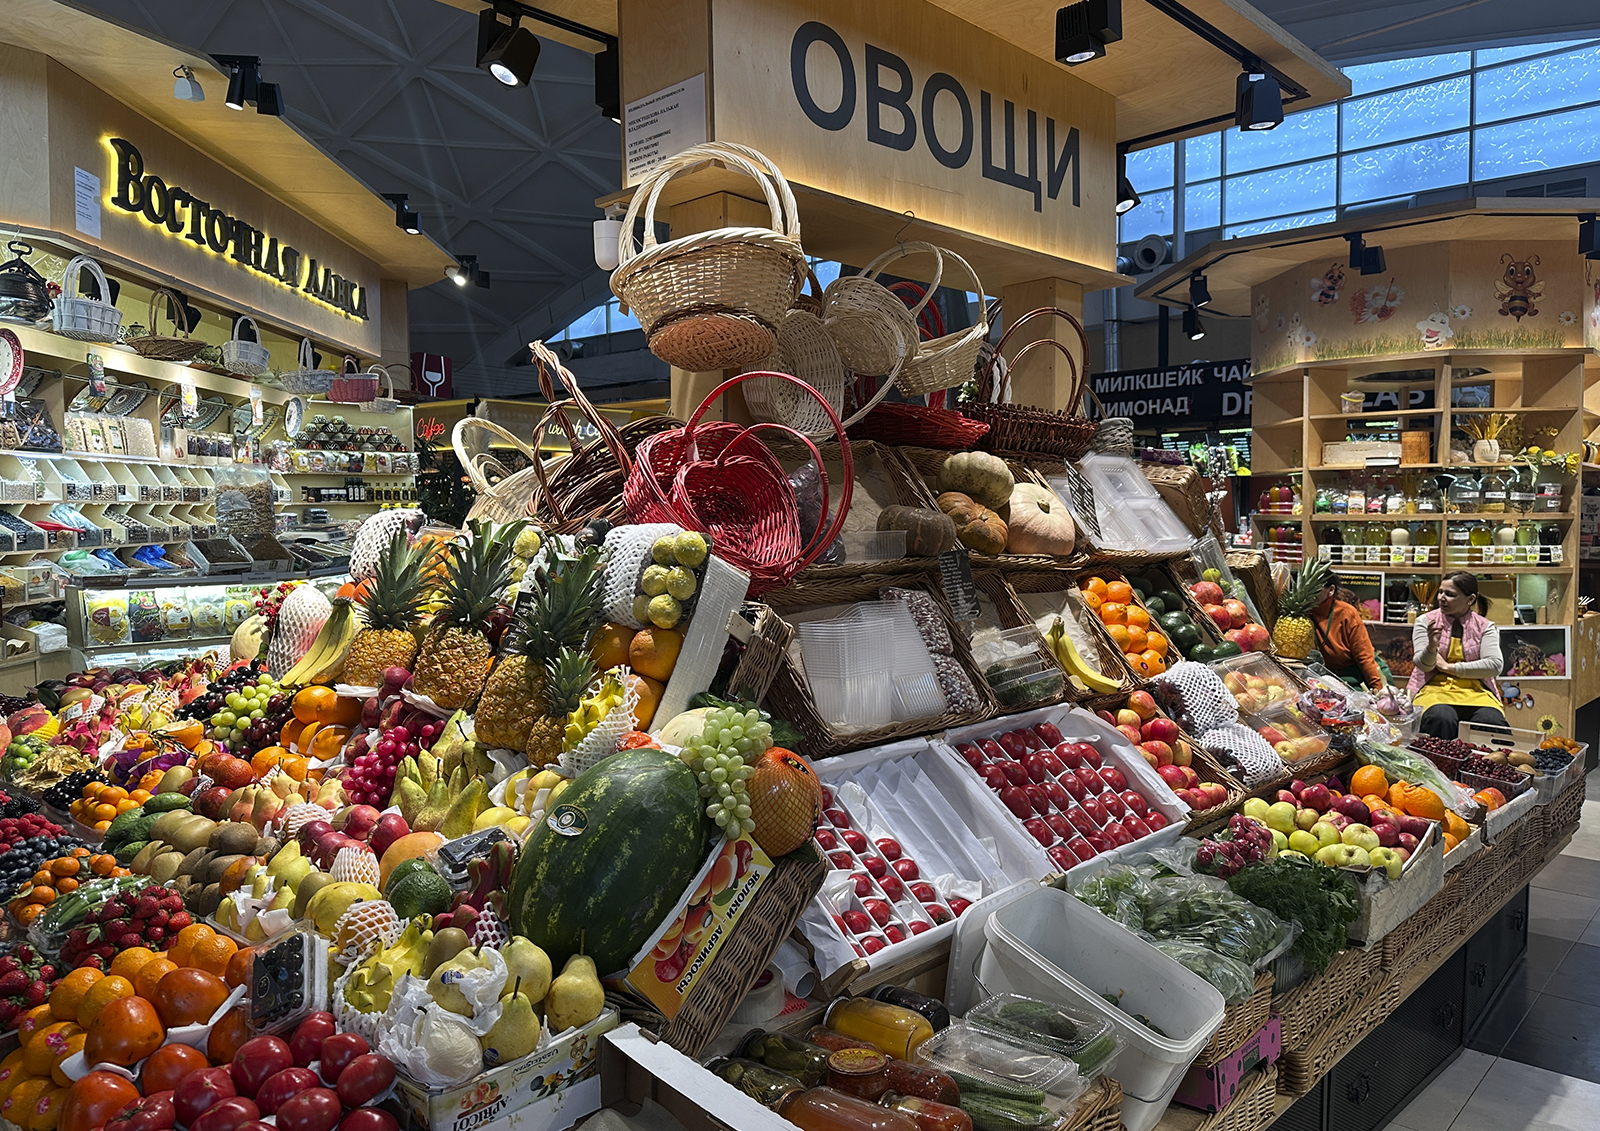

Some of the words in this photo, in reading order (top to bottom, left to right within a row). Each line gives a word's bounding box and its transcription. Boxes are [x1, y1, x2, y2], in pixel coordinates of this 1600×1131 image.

[790, 21, 1081, 213] ОВОЩИ
[1095, 366, 1204, 394] МИЛКШЕЙК
[1094, 396, 1190, 418] ЛИМОНАД
[416, 417, 446, 441] Coffee
[725, 870, 761, 920] ЯБЛОКИ
[675, 923, 724, 995] АБРИКОСЫ
